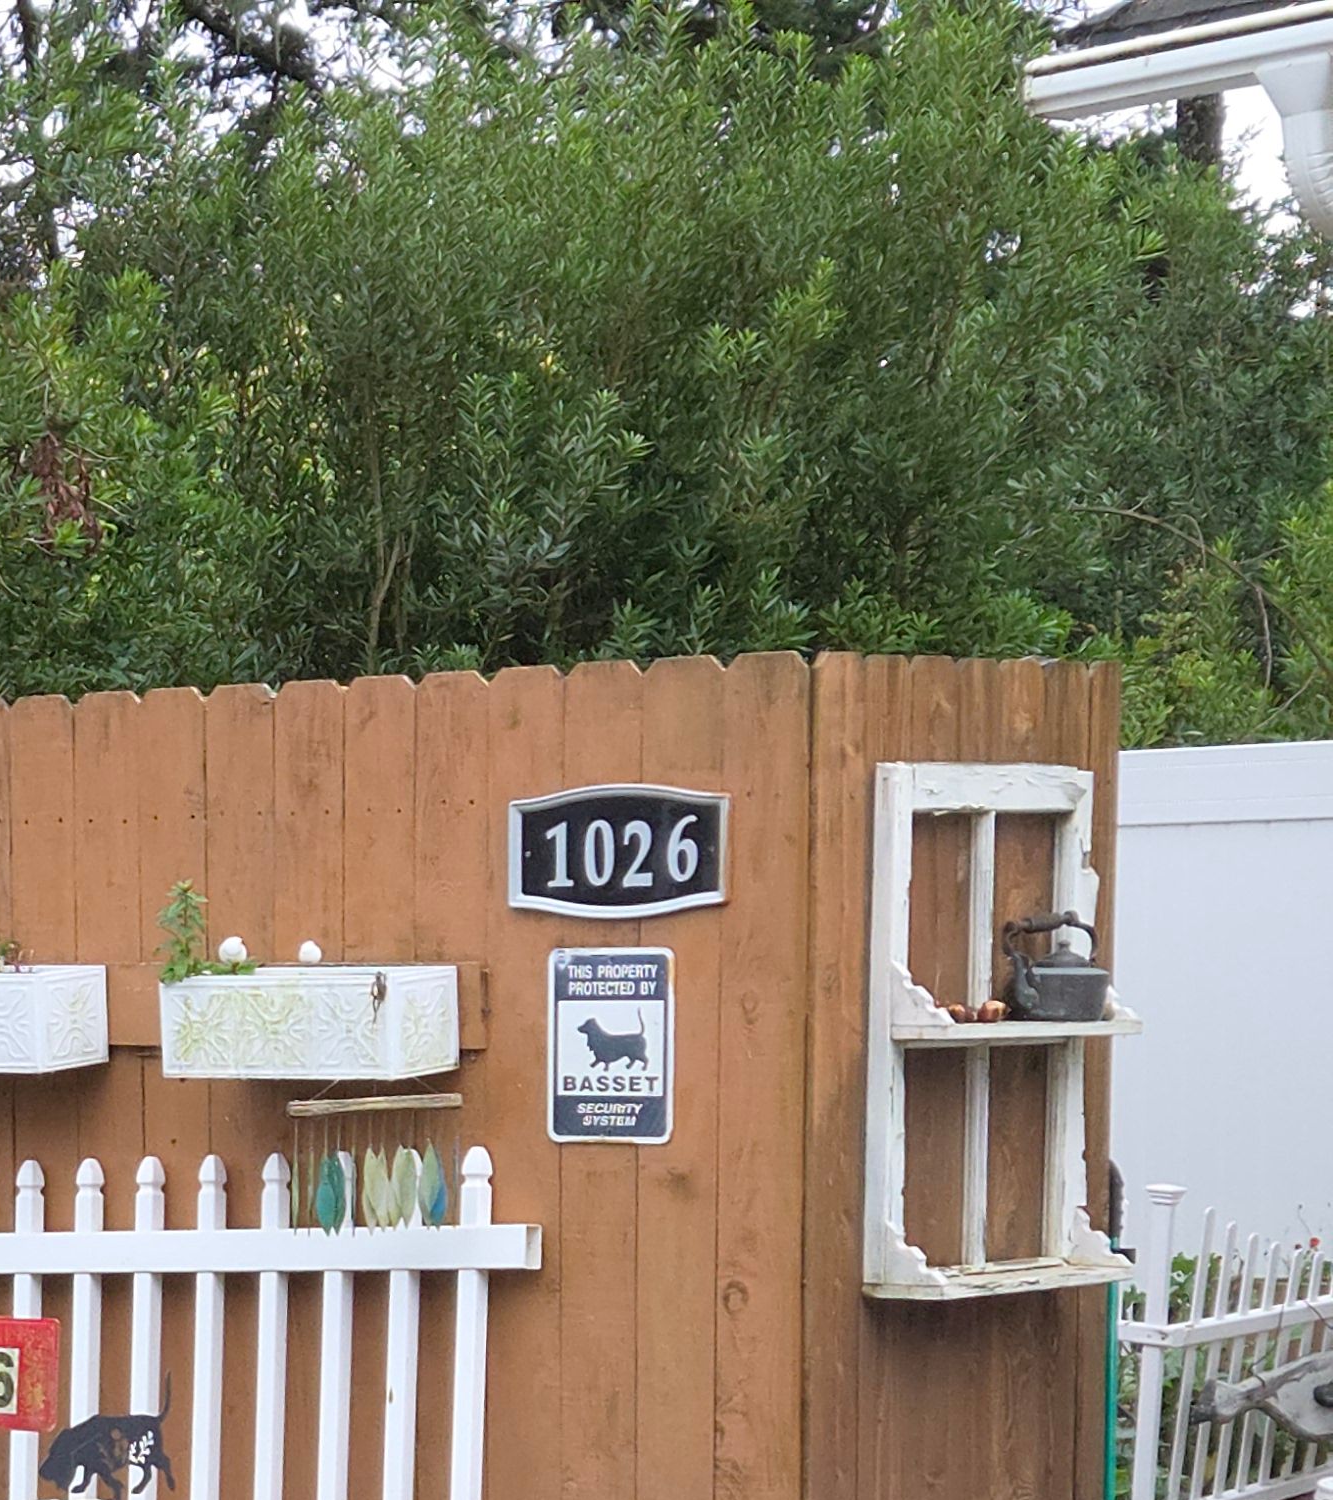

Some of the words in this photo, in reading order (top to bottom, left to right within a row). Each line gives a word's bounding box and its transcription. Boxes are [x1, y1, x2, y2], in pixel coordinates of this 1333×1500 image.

[545, 814, 700, 888] 1026
[567, 965, 593, 979] THIS
[597, 964, 658, 980] PROPERTY
[568, 981, 635, 996] PROTECTED
[640, 981, 657, 996] BY
[563, 1075, 659, 1092] BASSET
[577, 1103, 643, 1115] SECURITY
[583, 1115, 637, 1126] SYSTEM
